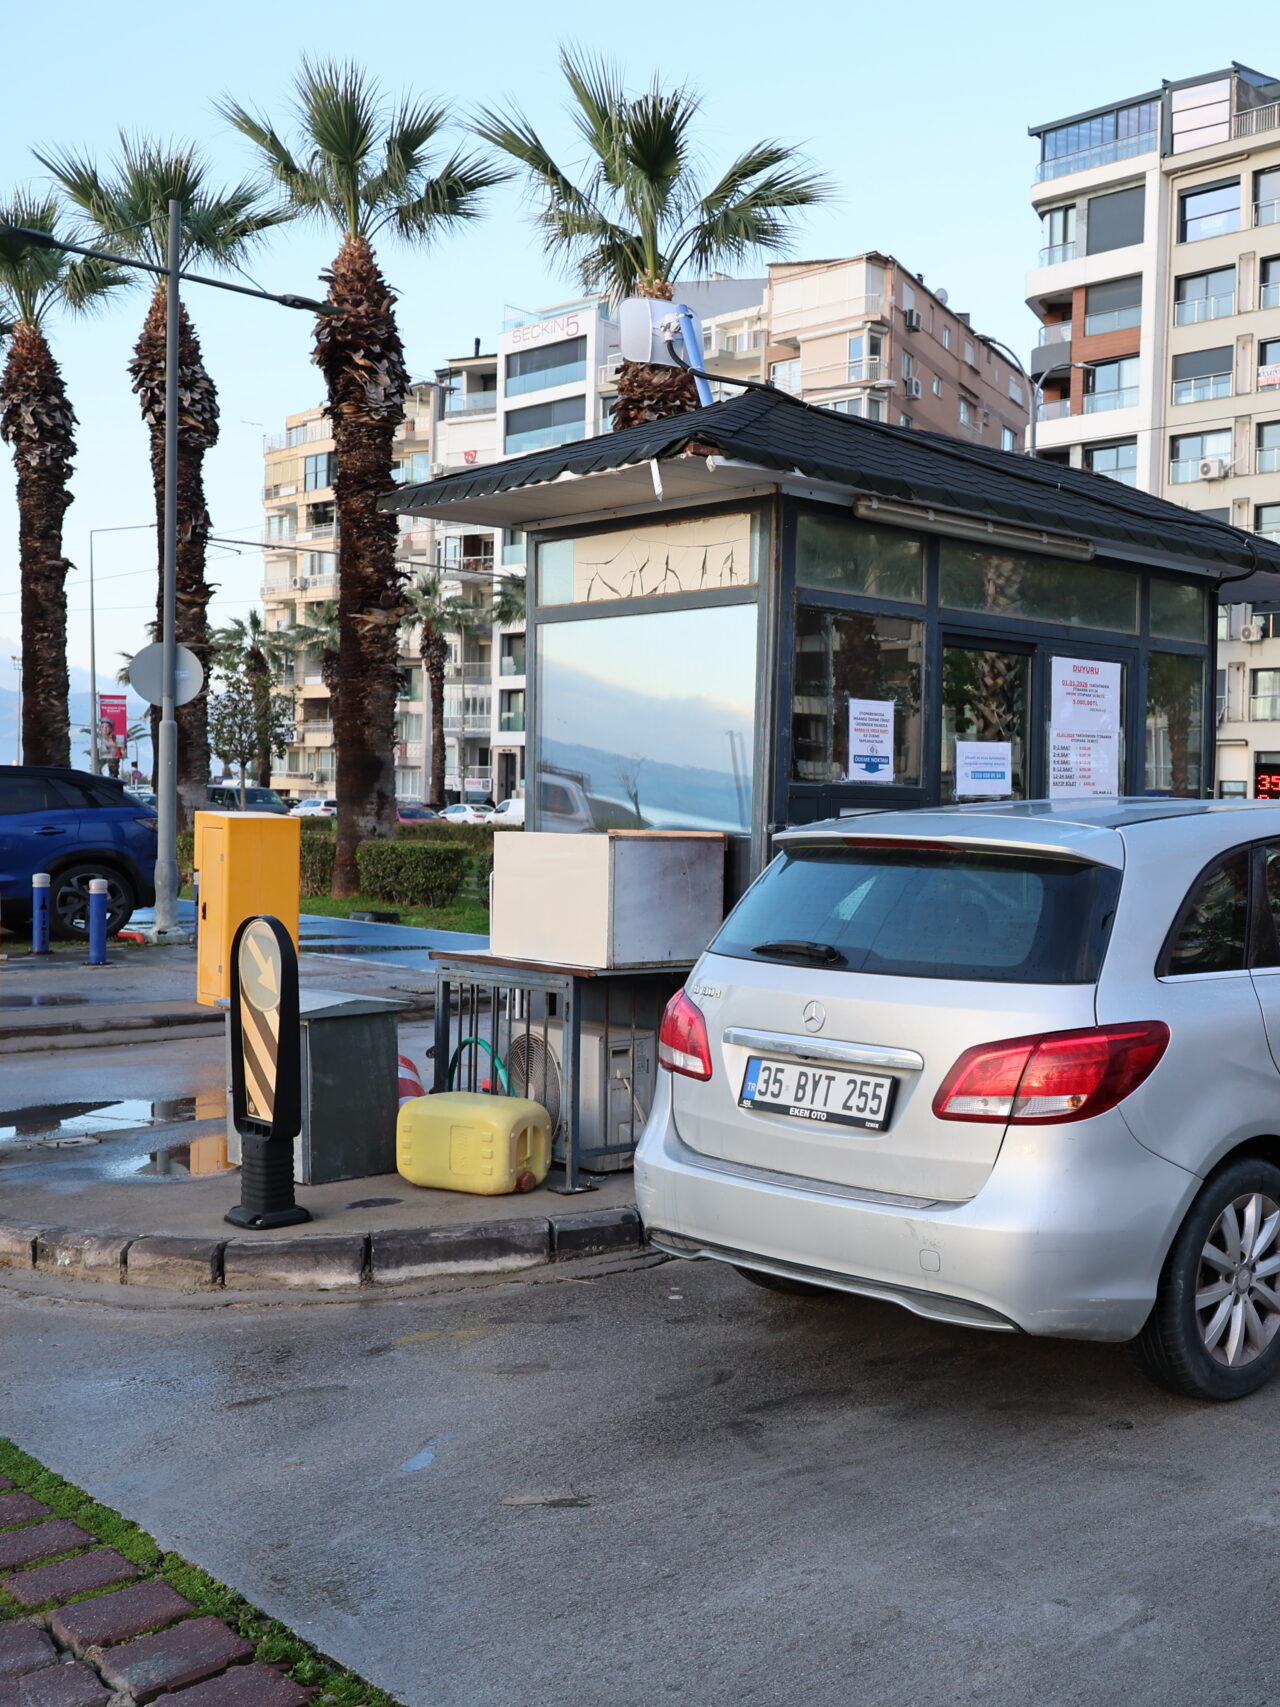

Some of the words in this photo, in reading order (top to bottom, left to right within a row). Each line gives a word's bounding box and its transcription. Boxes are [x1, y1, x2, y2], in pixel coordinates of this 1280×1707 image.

[1072, 664, 1100, 675] DUYURU
[747, 1082, 757, 1092] TR
[757, 1066, 785, 1099] 35
[793, 1071, 836, 1107] BYT
[842, 1079, 884, 1116] 255
[789, 1107, 810, 1118] EKEN
[811, 1110, 827, 1121] OTO
